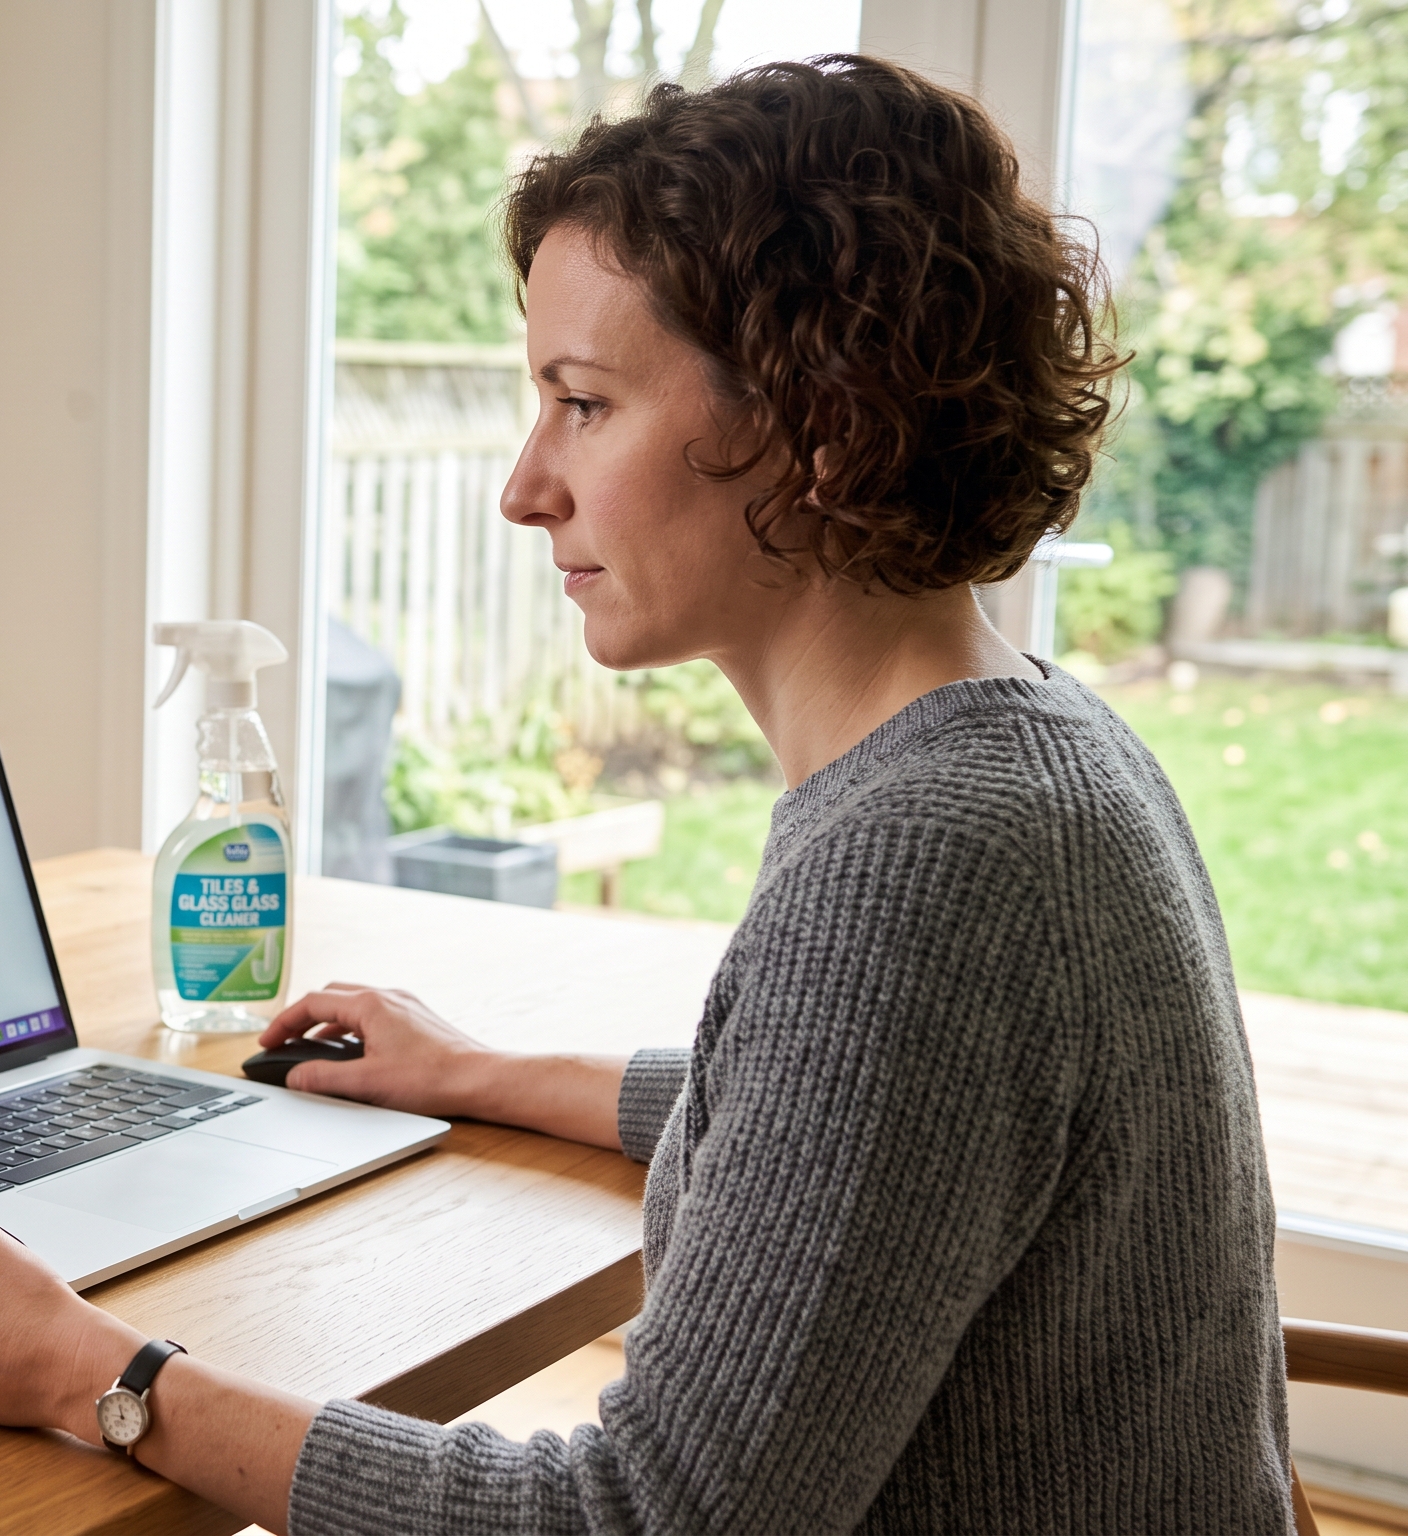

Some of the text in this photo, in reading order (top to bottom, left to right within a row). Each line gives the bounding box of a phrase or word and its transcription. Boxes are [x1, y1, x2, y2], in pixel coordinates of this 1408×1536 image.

[200, 878, 260, 895] TILES &
[178, 893, 280, 912] GLASS GLASS
[199, 911, 260, 927] CLEANER
